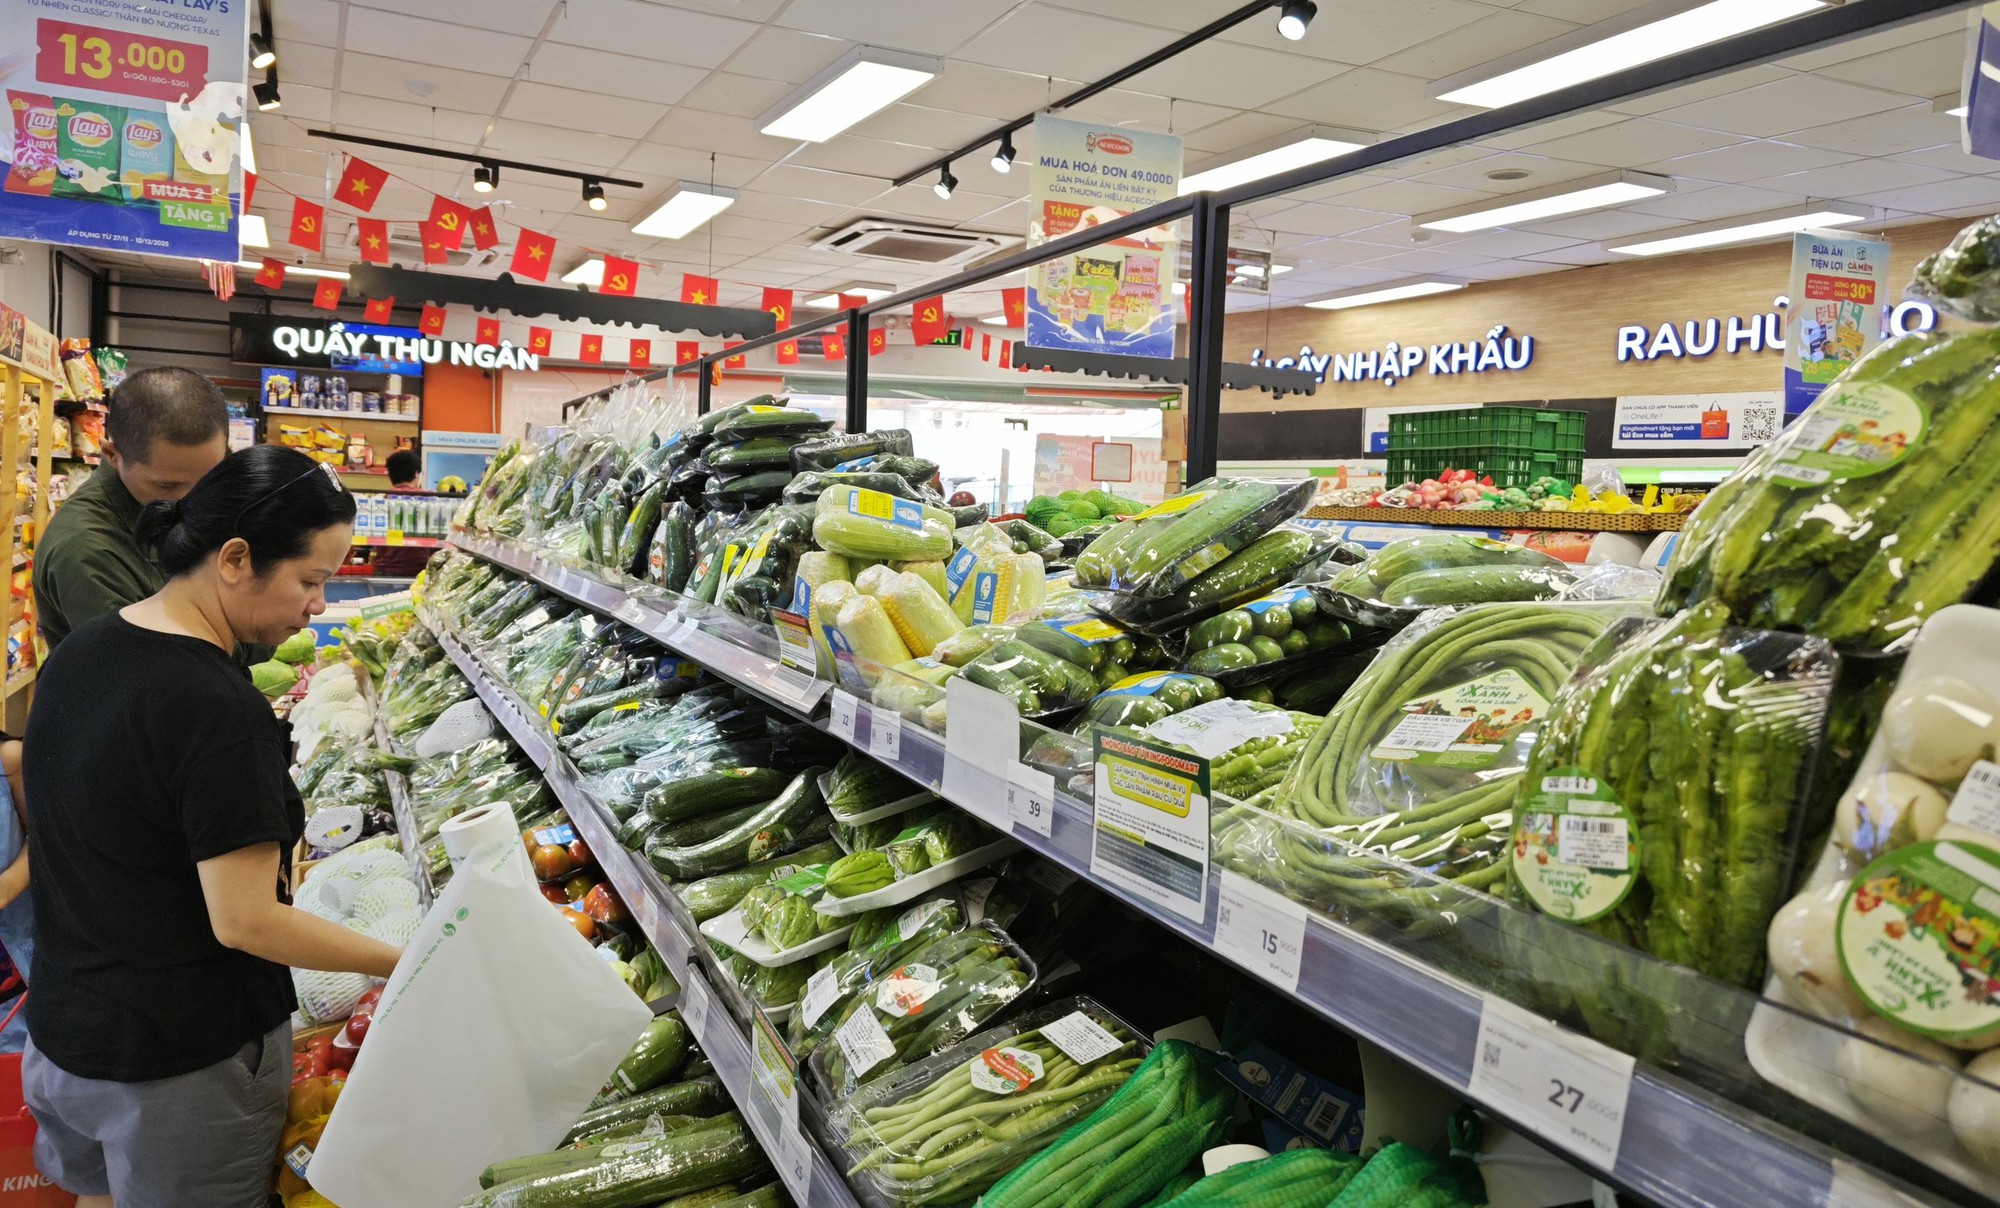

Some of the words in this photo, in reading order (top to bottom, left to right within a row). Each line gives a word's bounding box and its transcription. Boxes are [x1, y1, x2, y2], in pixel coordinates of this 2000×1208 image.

[71, 4, 113, 18] CLASSIC/
[192, 26, 220, 36] TEXAS
[144, 8, 160, 16] MAI
[71, 117, 109, 139] Lay's
[128, 124, 160, 142] Lay's
[1040, 156, 1069, 170] MUA
[1102, 165, 1127, 179] ĐƠN
[164, 204, 214, 223] TẶNG
[1049, 205, 1080, 220] TẶNG
[1850, 282, 1873, 299] 30%
[272, 321, 367, 359] QUẦY
[373, 334, 443, 363] THU
[450, 340, 540, 371] NGÂN
[1617, 317, 1720, 363] RAU
[1333, 340, 1427, 388] NHẬP
[1429, 324, 1534, 376] KHẨU
[886, 732, 893, 746] 18
[1100, 735, 1122, 754] THÔNG
[1145, 749, 1200, 777] KINGFOODMART
[1150, 788, 1162, 800] RAU
[1028, 799, 1041, 818] 39
[1261, 929, 1278, 955] 15
[1547, 1077, 1585, 1114] 27
